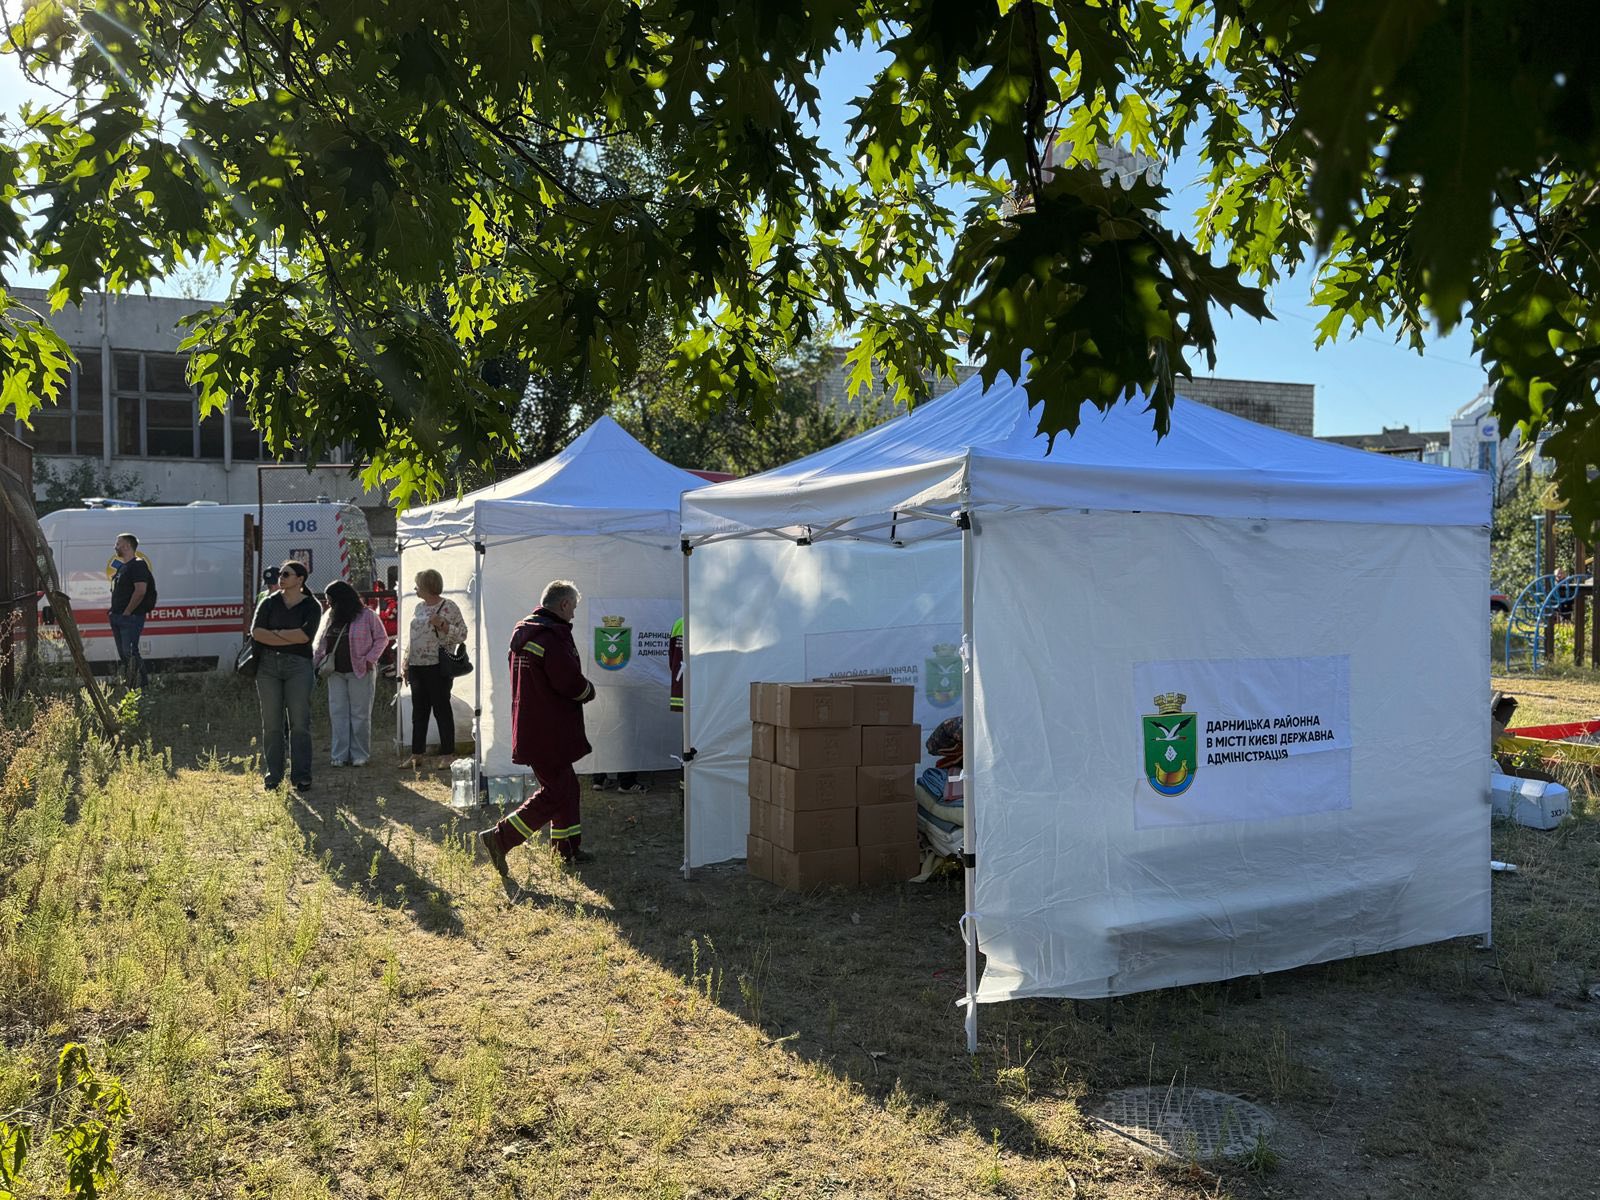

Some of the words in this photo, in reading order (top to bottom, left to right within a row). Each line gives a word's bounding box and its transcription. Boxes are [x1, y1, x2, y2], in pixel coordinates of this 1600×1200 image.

[288, 520, 317, 532] 108
[1206, 719, 1270, 734] ДАРНИЦЬКА
[1273, 714, 1320, 728] РАЙОННА
[1206, 737, 1213, 748] В
[1215, 735, 1246, 748] МІСТІ
[1248, 734, 1277, 746] КИЄВІ
[1280, 729, 1334, 745] ДЕРЖАВНА
[1207, 749, 1288, 765] АДМІНІСТРАЦІЯ
